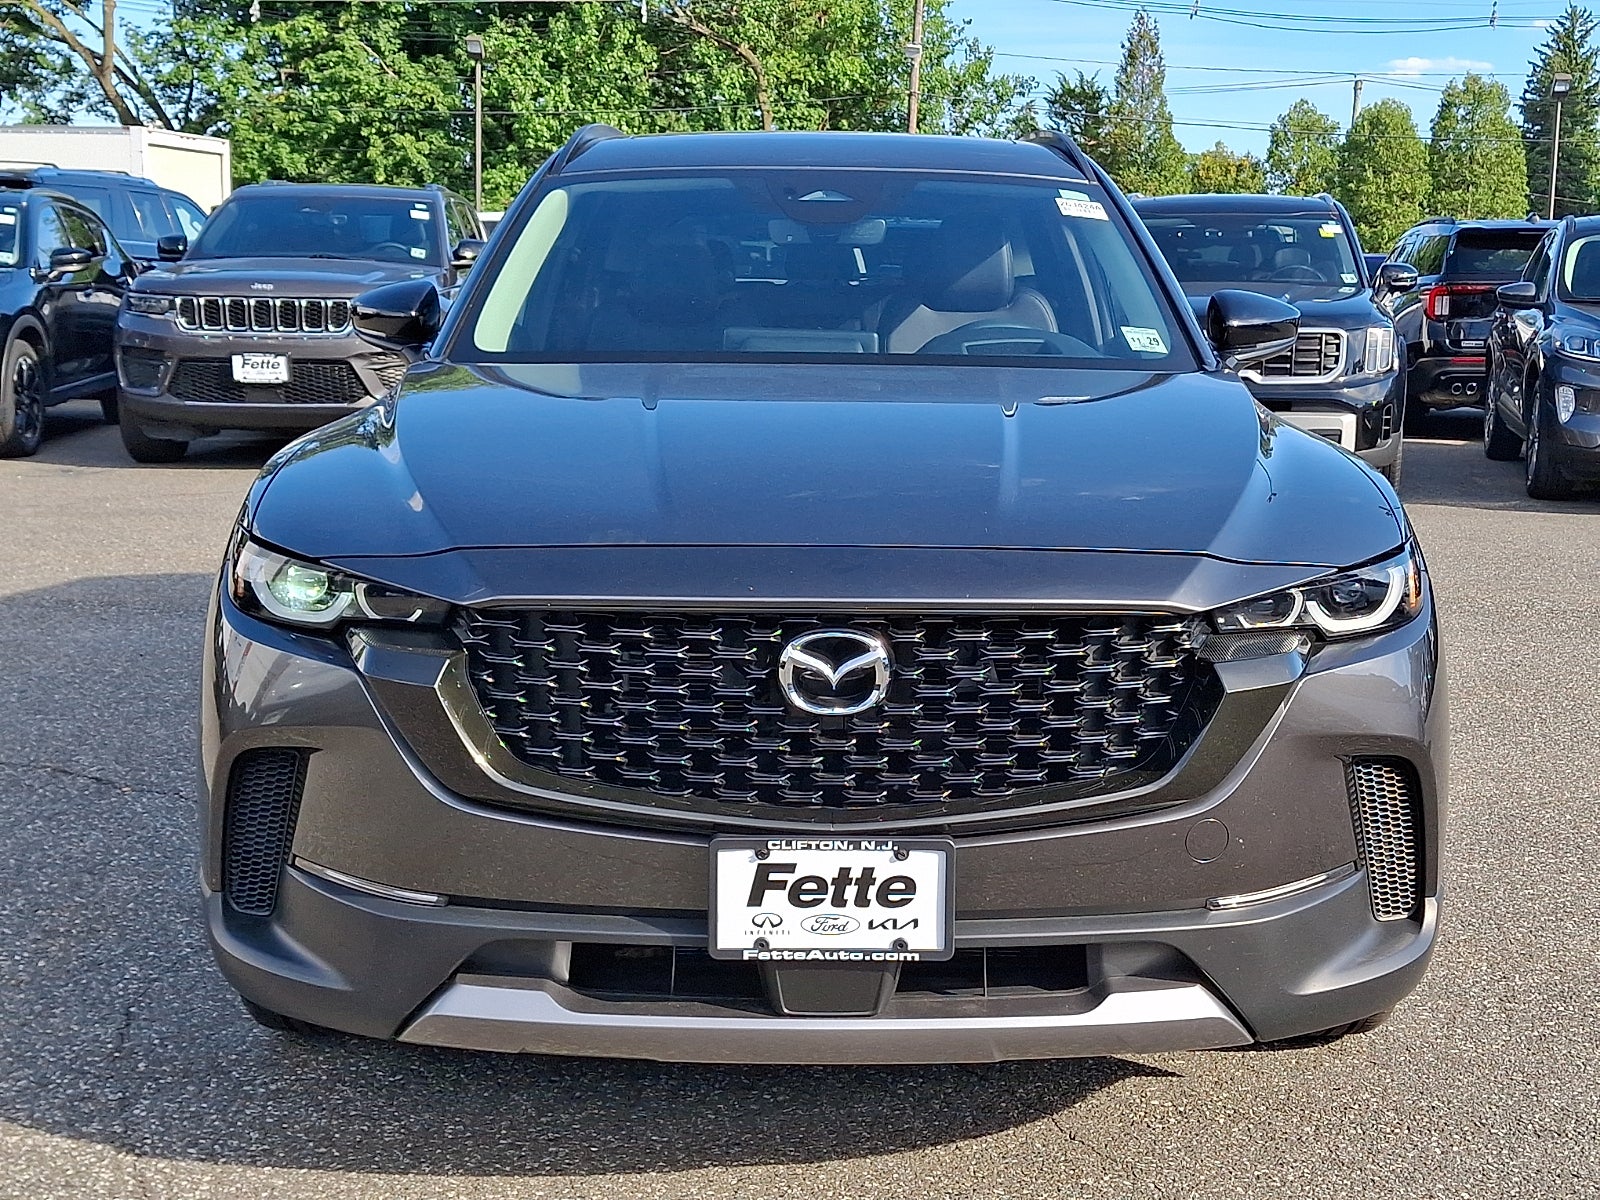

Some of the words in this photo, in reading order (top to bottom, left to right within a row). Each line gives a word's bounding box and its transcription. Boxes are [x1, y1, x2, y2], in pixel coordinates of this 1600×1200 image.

[250, 282, 274, 291] Jeep
[1147, 336, 1160, 346] 29
[241, 358, 281, 370] Fette
[860, 840, 899, 851] N.J.
[746, 862, 917, 909] Fette
[810, 916, 850, 932] Ford
[742, 949, 920, 962] FetteAuto.com
